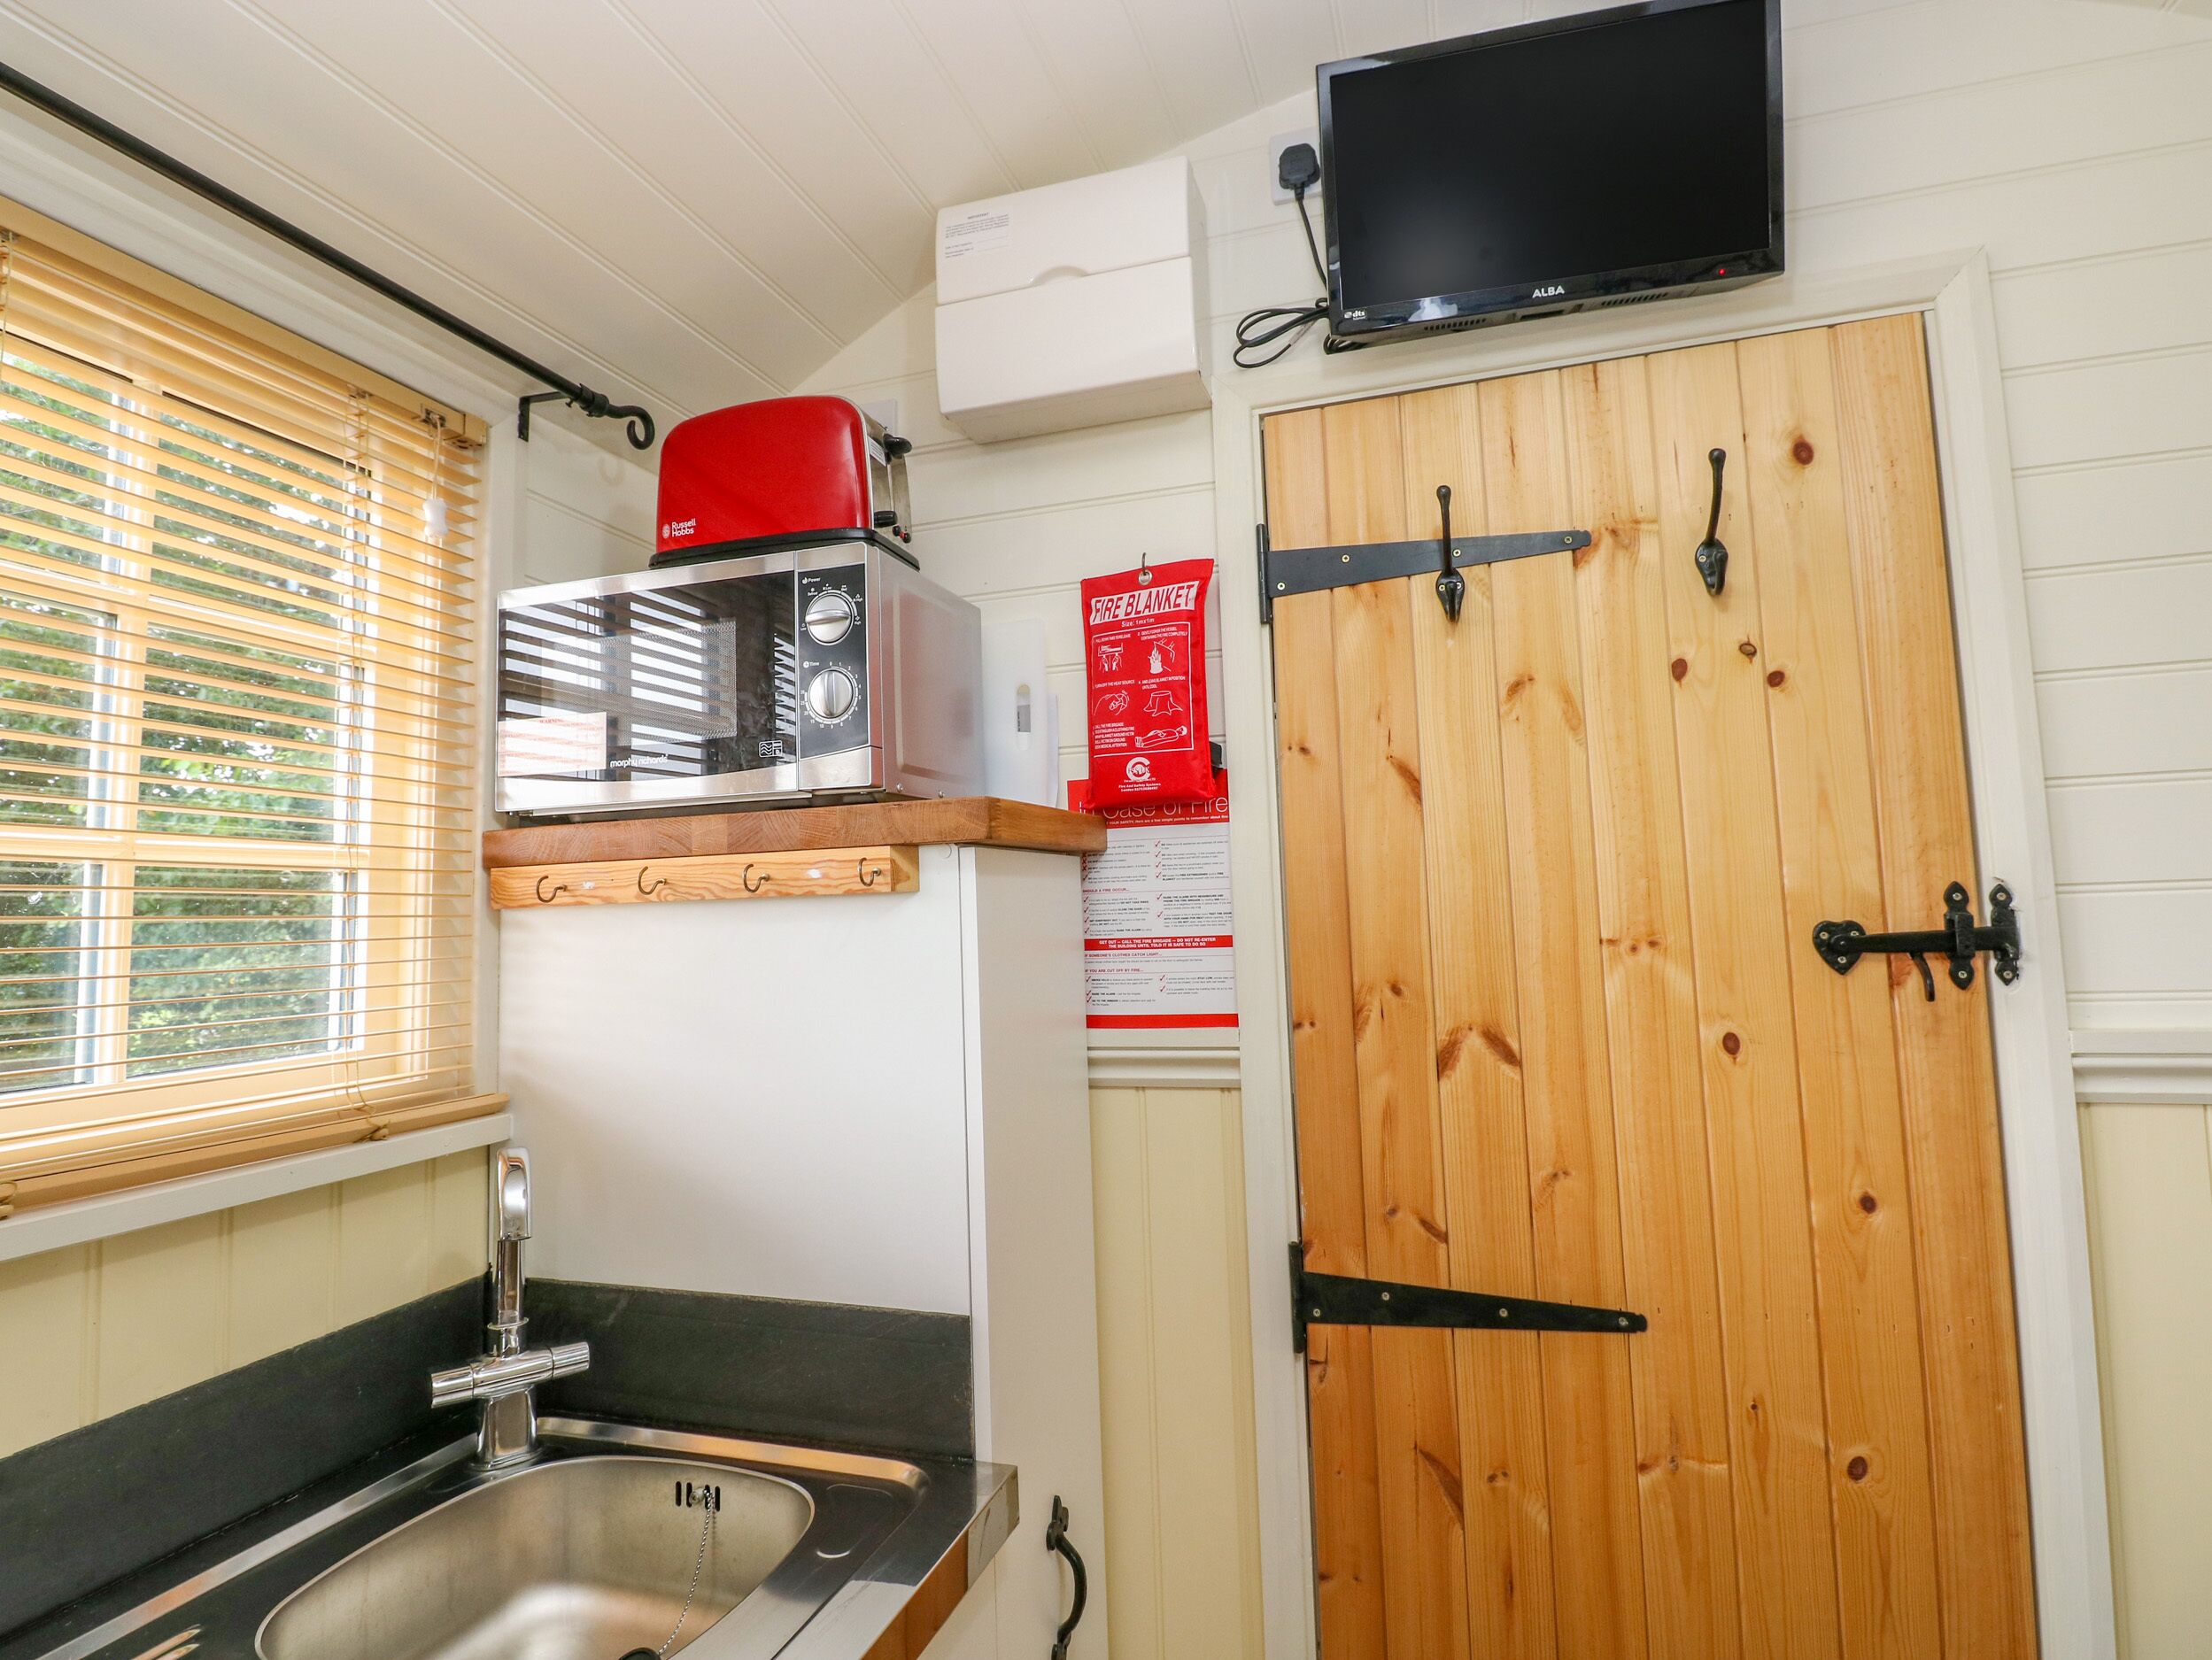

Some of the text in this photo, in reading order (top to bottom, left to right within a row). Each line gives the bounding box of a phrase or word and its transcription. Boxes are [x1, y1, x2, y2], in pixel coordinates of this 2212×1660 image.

[1532, 285, 1565, 297] ALBA
[672, 518, 696, 529] Russell
[672, 527, 694, 537] Hobbs
[1093, 584, 1195, 622] FIRE BLANKET
[610, 754, 667, 768] morphy richards
[1191, 797, 1228, 814] Fire
